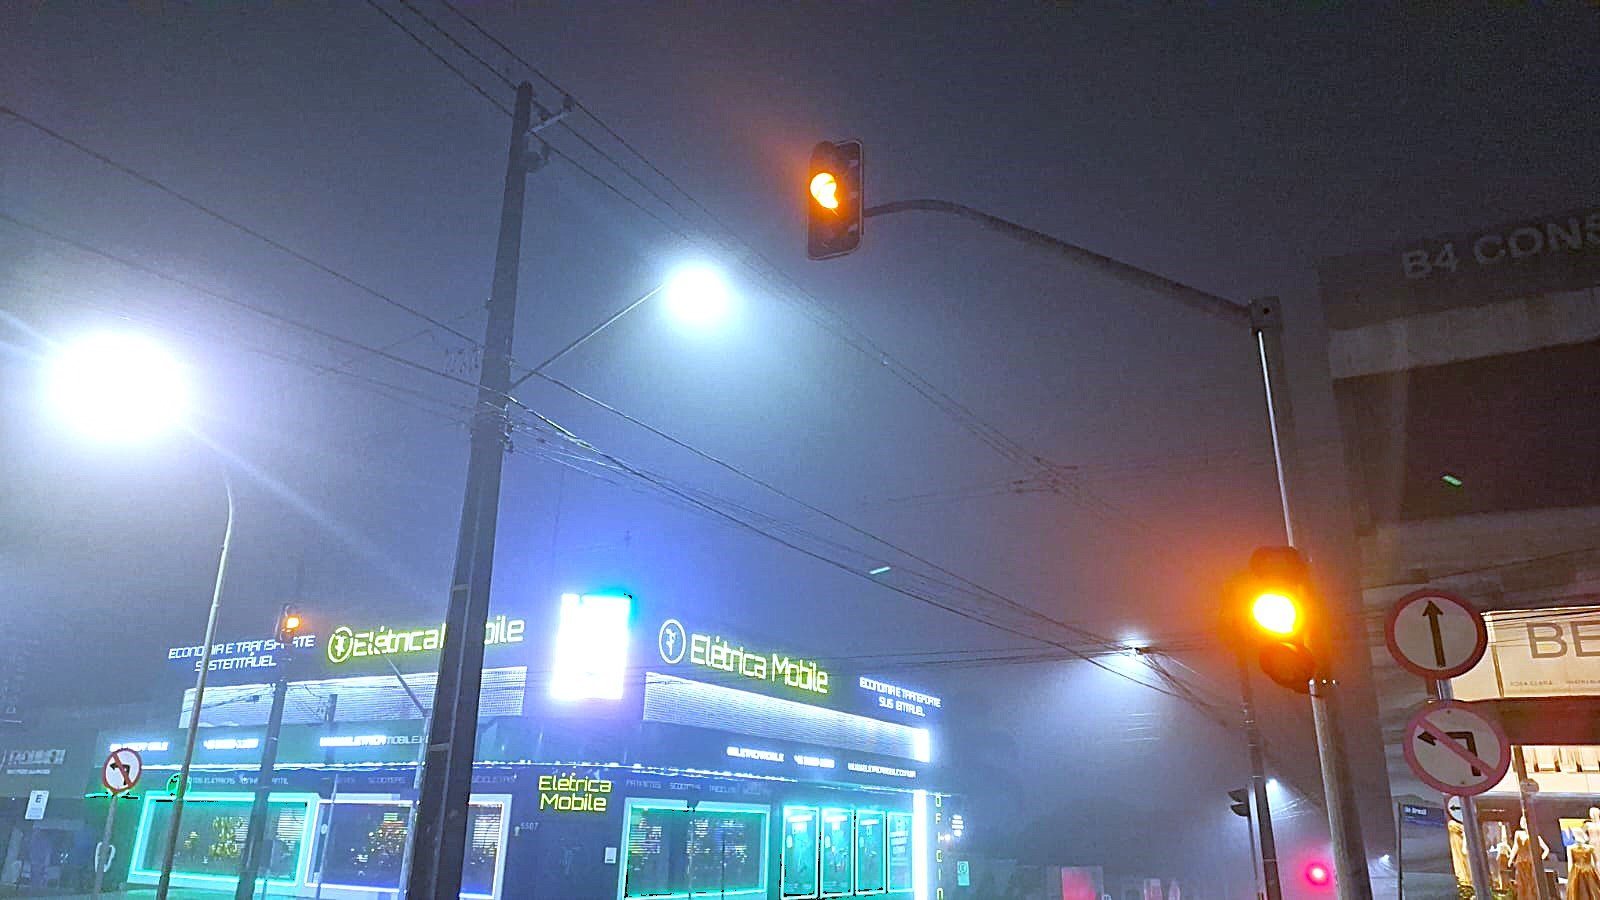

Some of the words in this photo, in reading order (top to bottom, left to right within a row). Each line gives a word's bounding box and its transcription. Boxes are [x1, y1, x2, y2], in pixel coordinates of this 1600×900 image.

[1402, 242, 1459, 280] B4
[1526, 620, 1600, 659] BE
[690, 633, 767, 680] Elétrica
[772, 653, 828, 694] Mobile
[540, 793, 607, 811] Mobile
